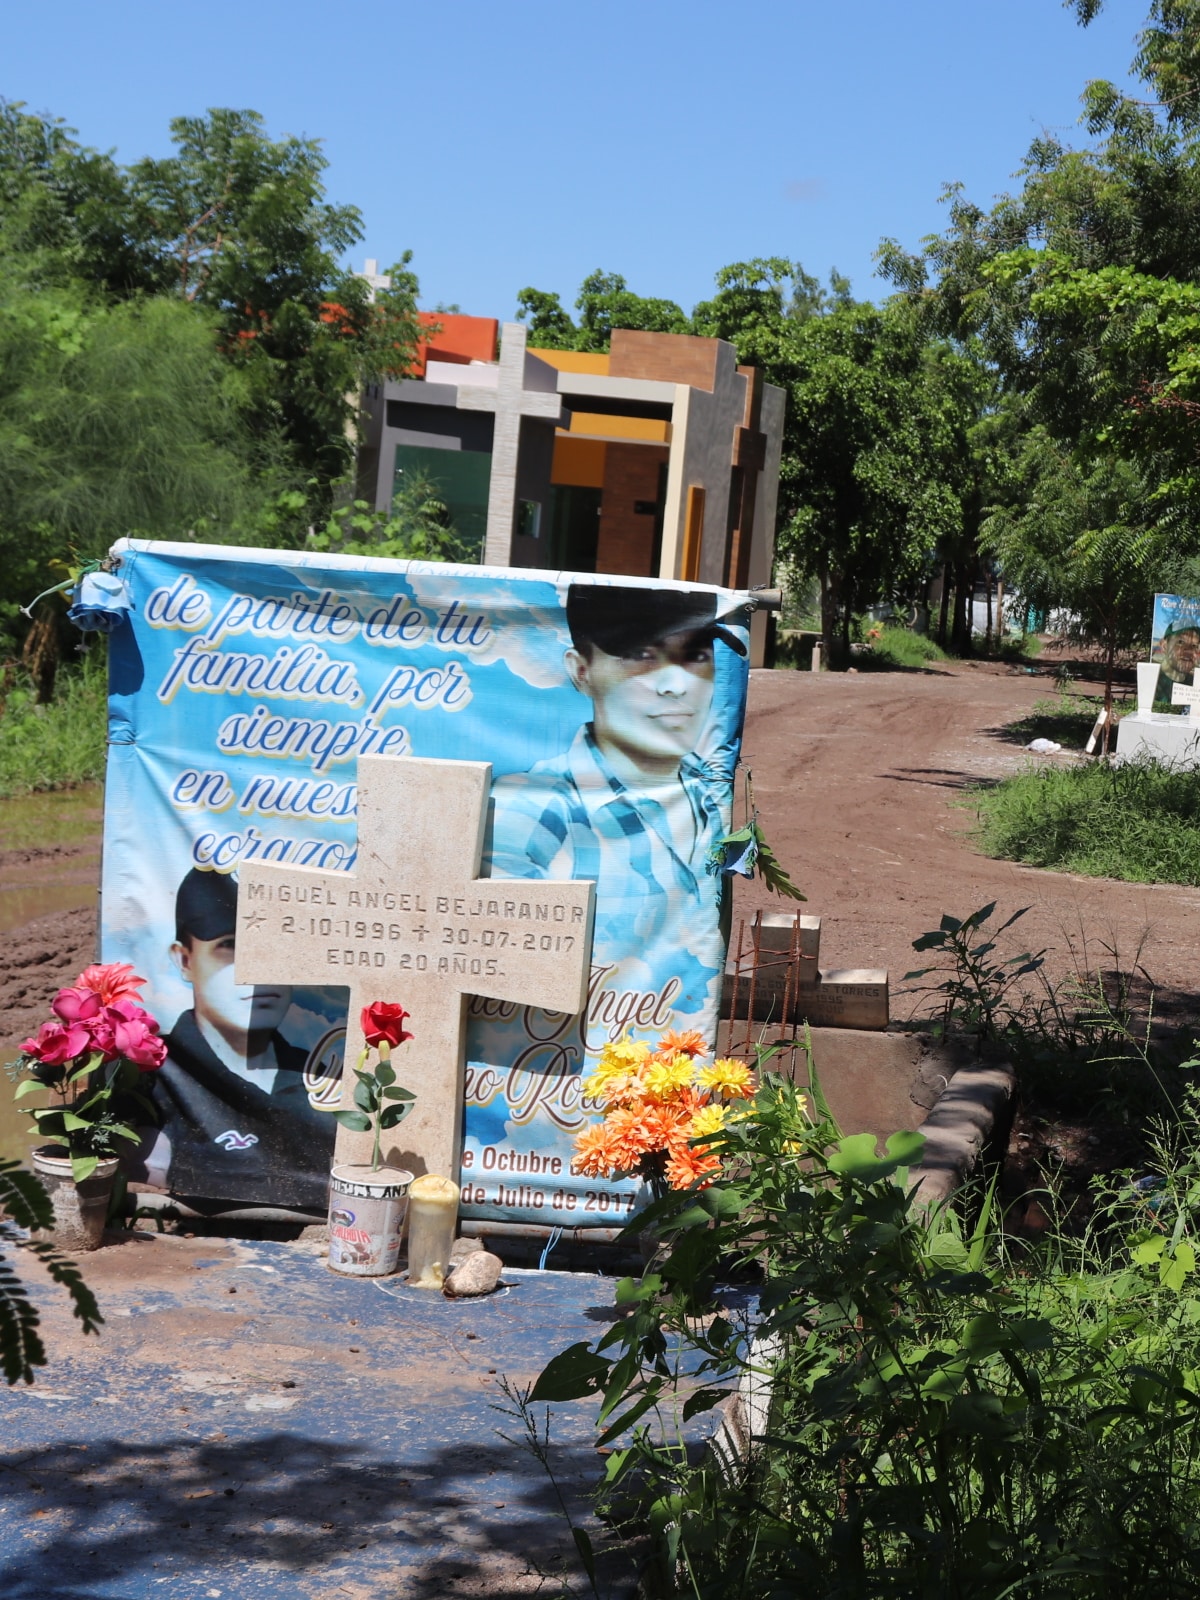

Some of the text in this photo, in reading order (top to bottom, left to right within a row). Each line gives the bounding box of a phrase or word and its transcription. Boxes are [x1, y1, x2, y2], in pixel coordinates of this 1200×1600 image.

[147, 574, 490, 646] de parte de tu
[158, 639, 469, 713] familia, por
[219, 708, 410, 769] siempre
[174, 770, 358, 814] en nues
[247, 883, 337, 907] MIGUEL
[348, 891, 427, 913] ANGEL
[326, 948, 386, 969] EDAD
[399, 954, 428, 972] 20
[833, 985, 880, 997] TORRES
[482, 1146, 562, 1175] Octubre
[461, 1182, 636, 1213] de Julio de 2017
